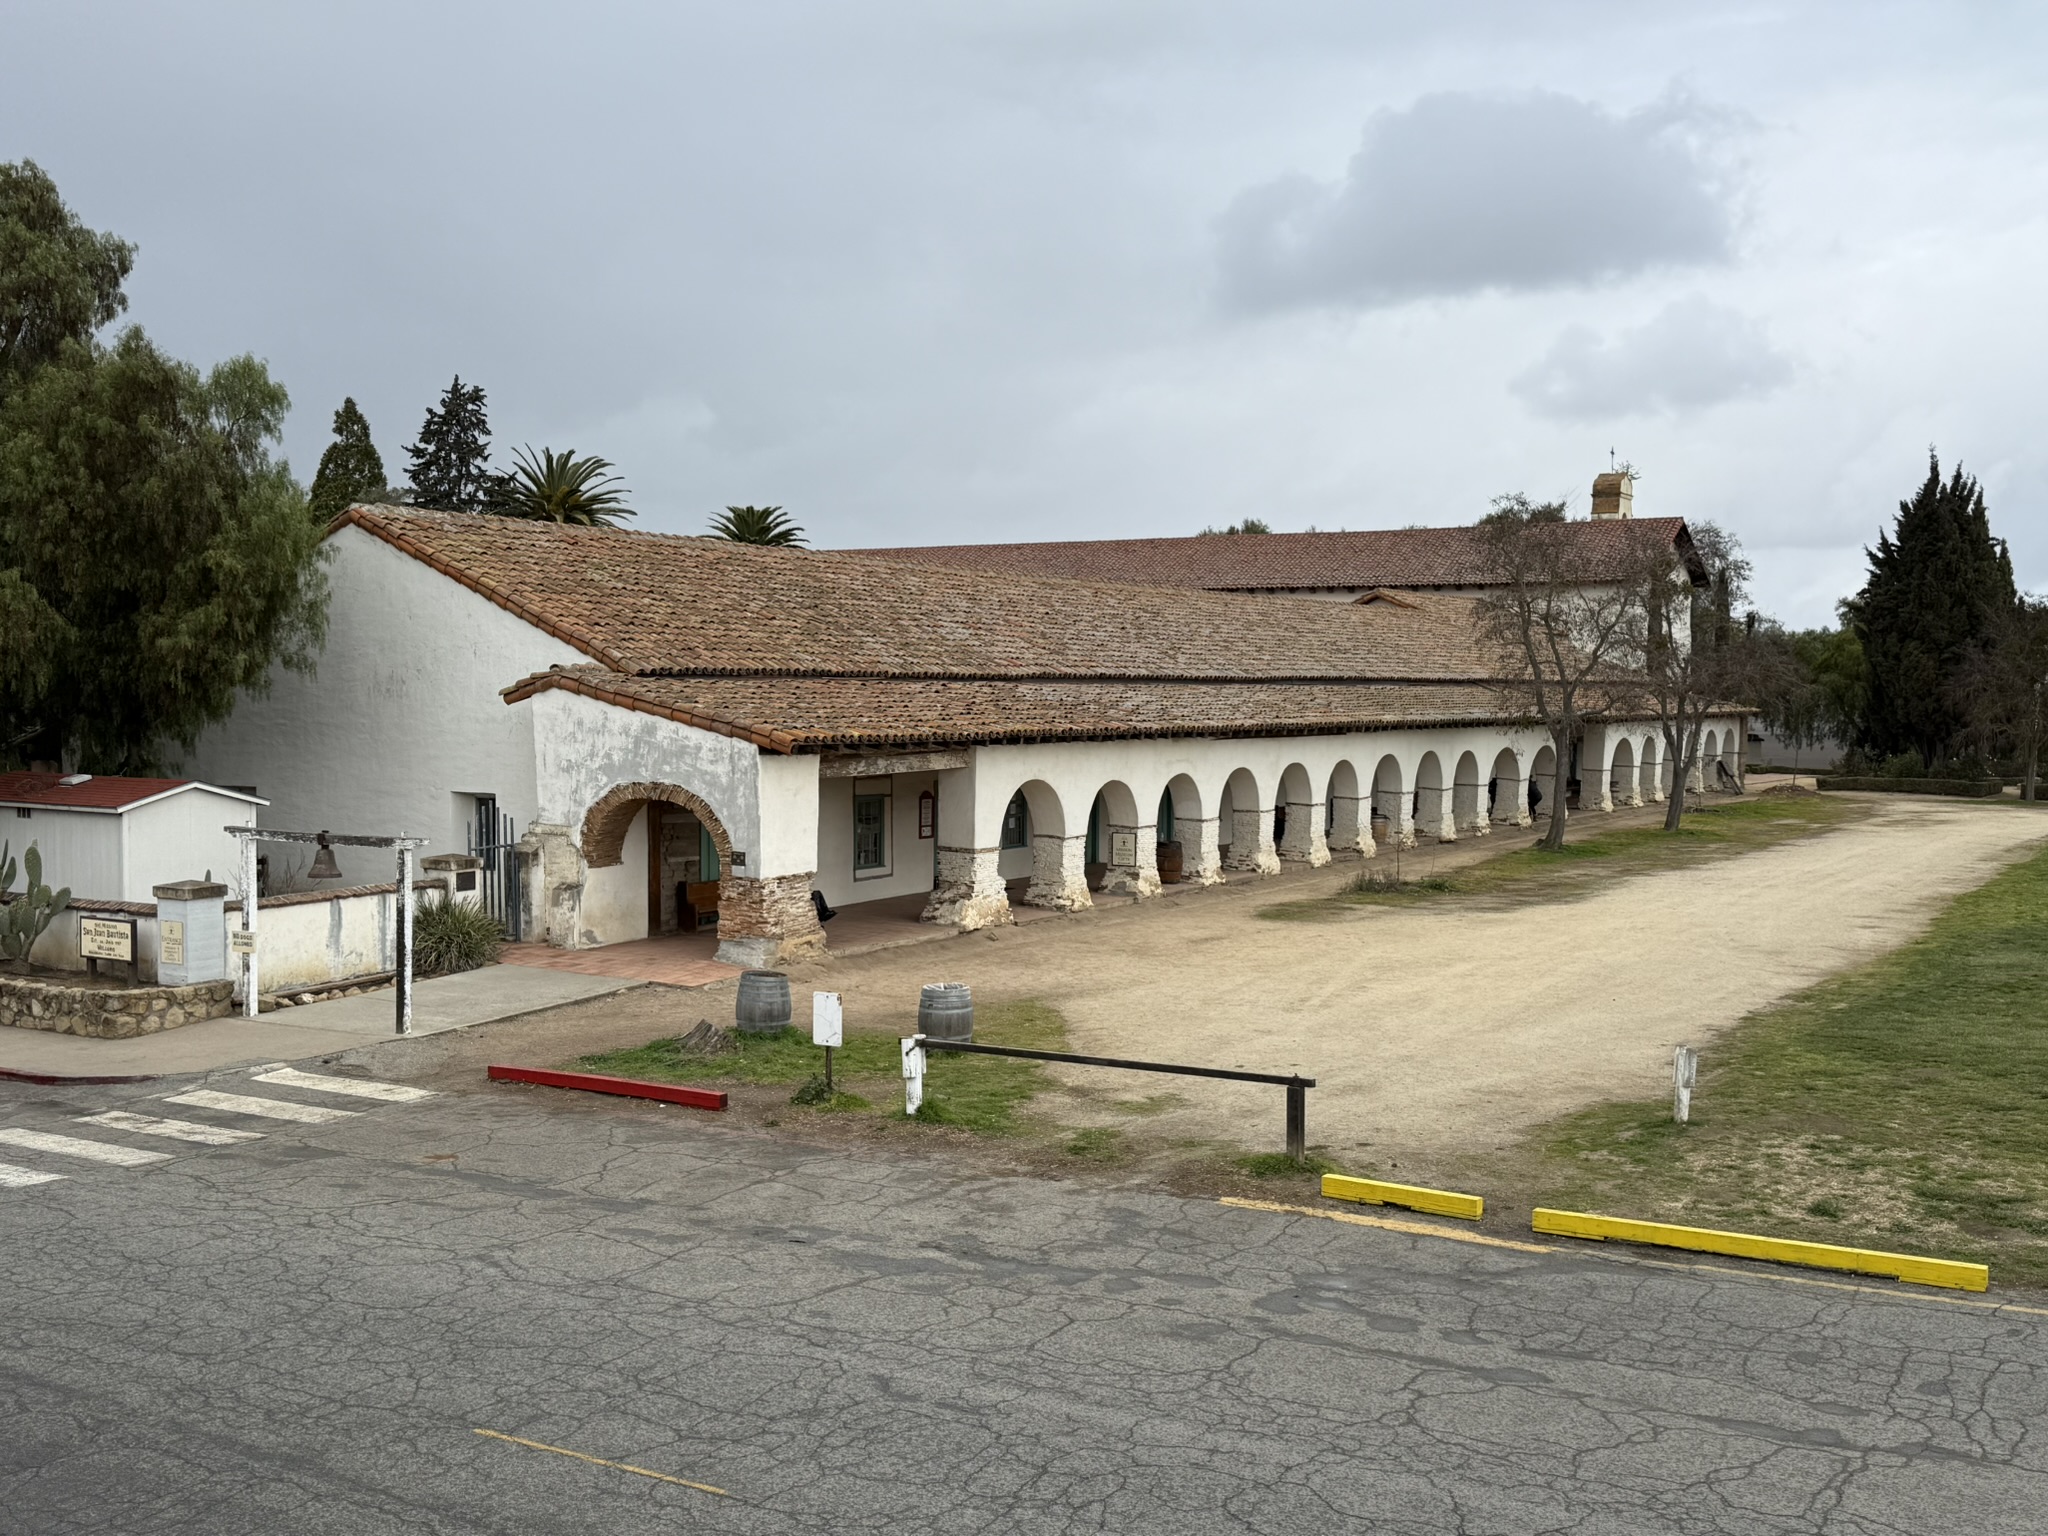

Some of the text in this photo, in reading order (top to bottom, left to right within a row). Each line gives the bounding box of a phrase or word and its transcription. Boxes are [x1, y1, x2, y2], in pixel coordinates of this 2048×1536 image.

[83, 927, 129, 939] San Juan Bautista
